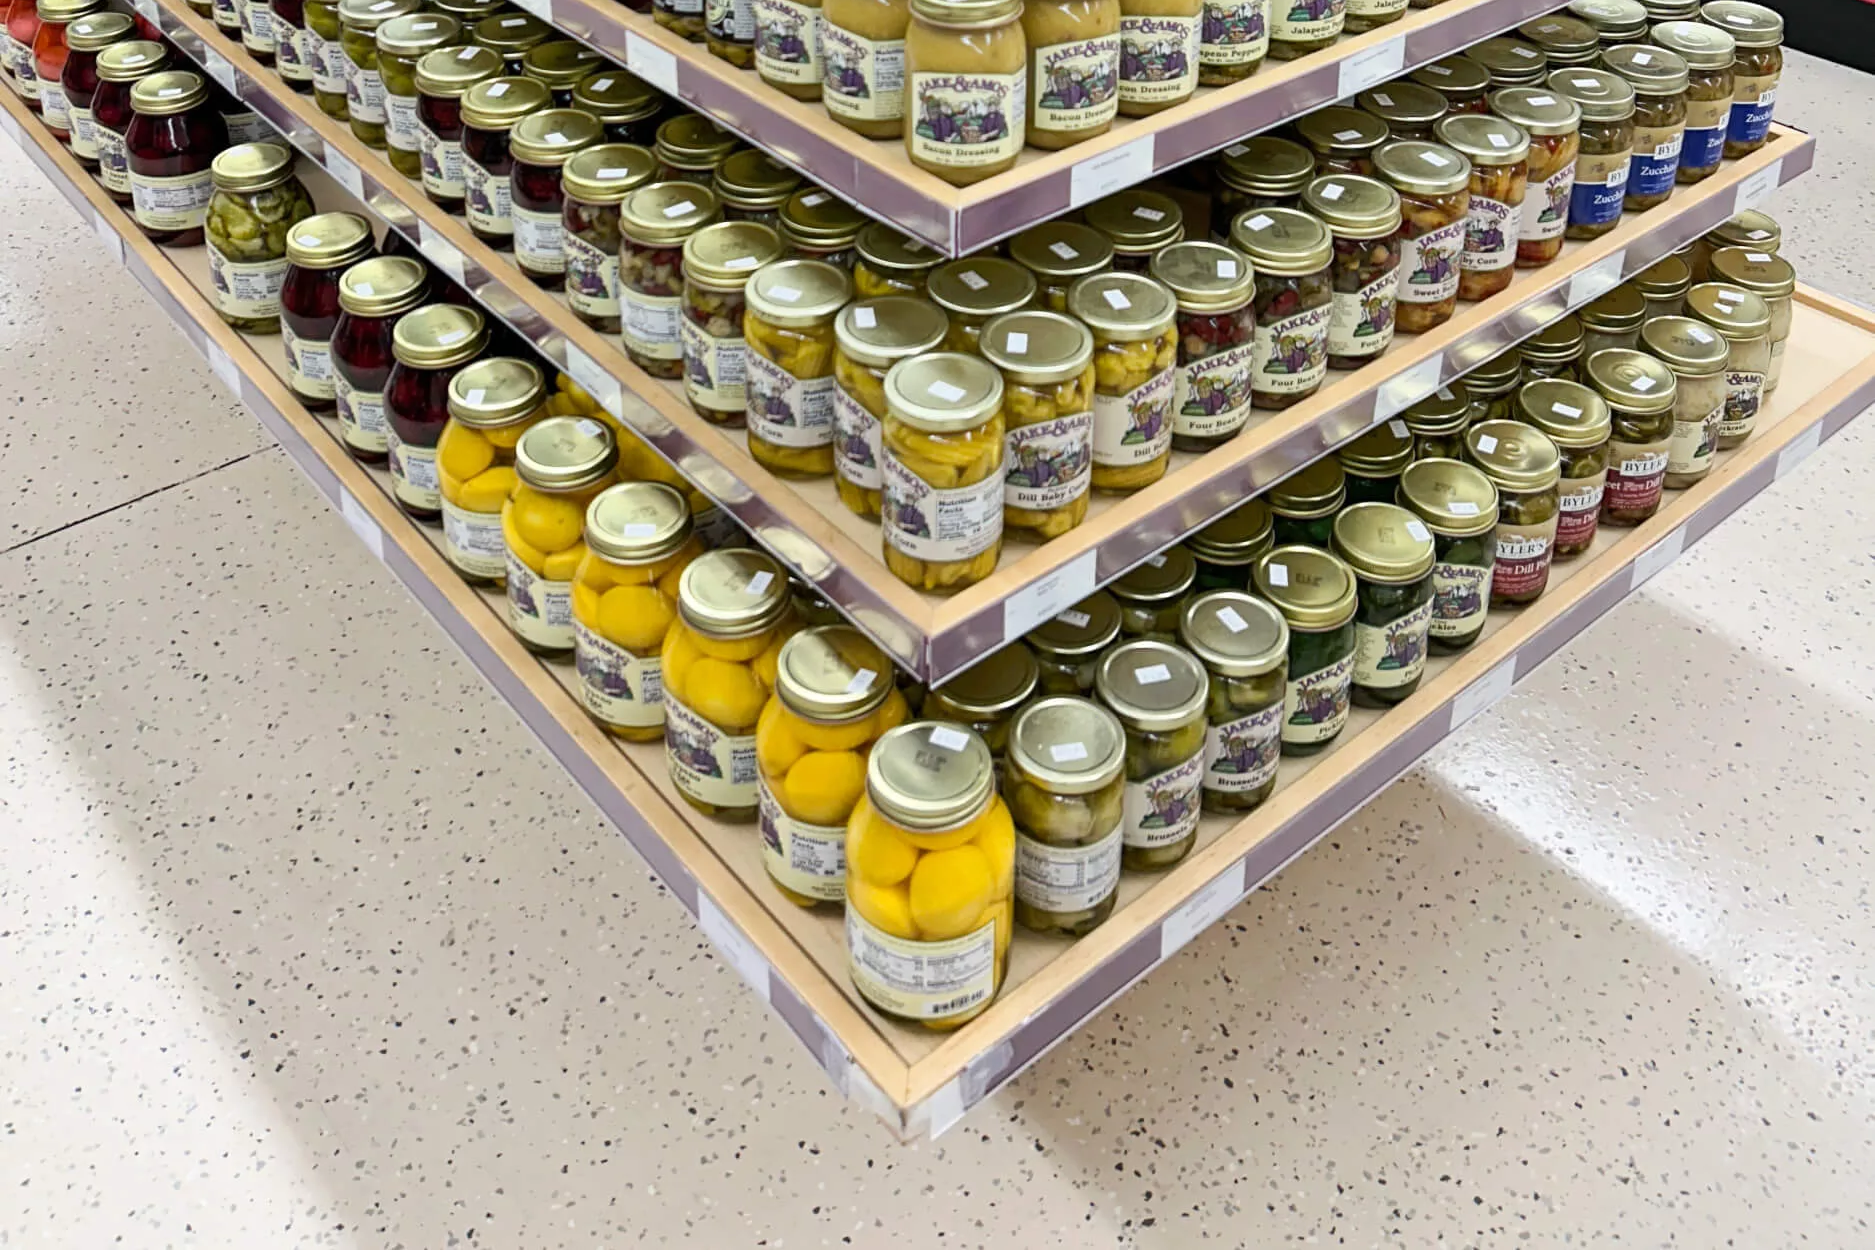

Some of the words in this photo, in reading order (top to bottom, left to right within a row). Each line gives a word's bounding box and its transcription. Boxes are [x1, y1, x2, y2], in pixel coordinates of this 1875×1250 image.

[1141, 83, 1181, 95] Dressing
[1050, 111, 1080, 122] Bacon
[922, 143, 952, 156] Bacon
[956, 143, 1000, 157] Dressing
[1476, 256, 1498, 265] Corn
[1414, 288, 1440, 296] Sweet
[1271, 378, 1295, 388] Four
[1189, 420, 1213, 431] Four
[1134, 448, 1151, 458] Dill
[939, 496, 977, 506] Nutrition
[1018, 491, 1037, 502] Dill
[1041, 490, 1065, 503] Baby
[1514, 562, 1534, 575] Dill
[1218, 774, 1260, 786] Brussels
[1147, 827, 1188, 842] Brussels
